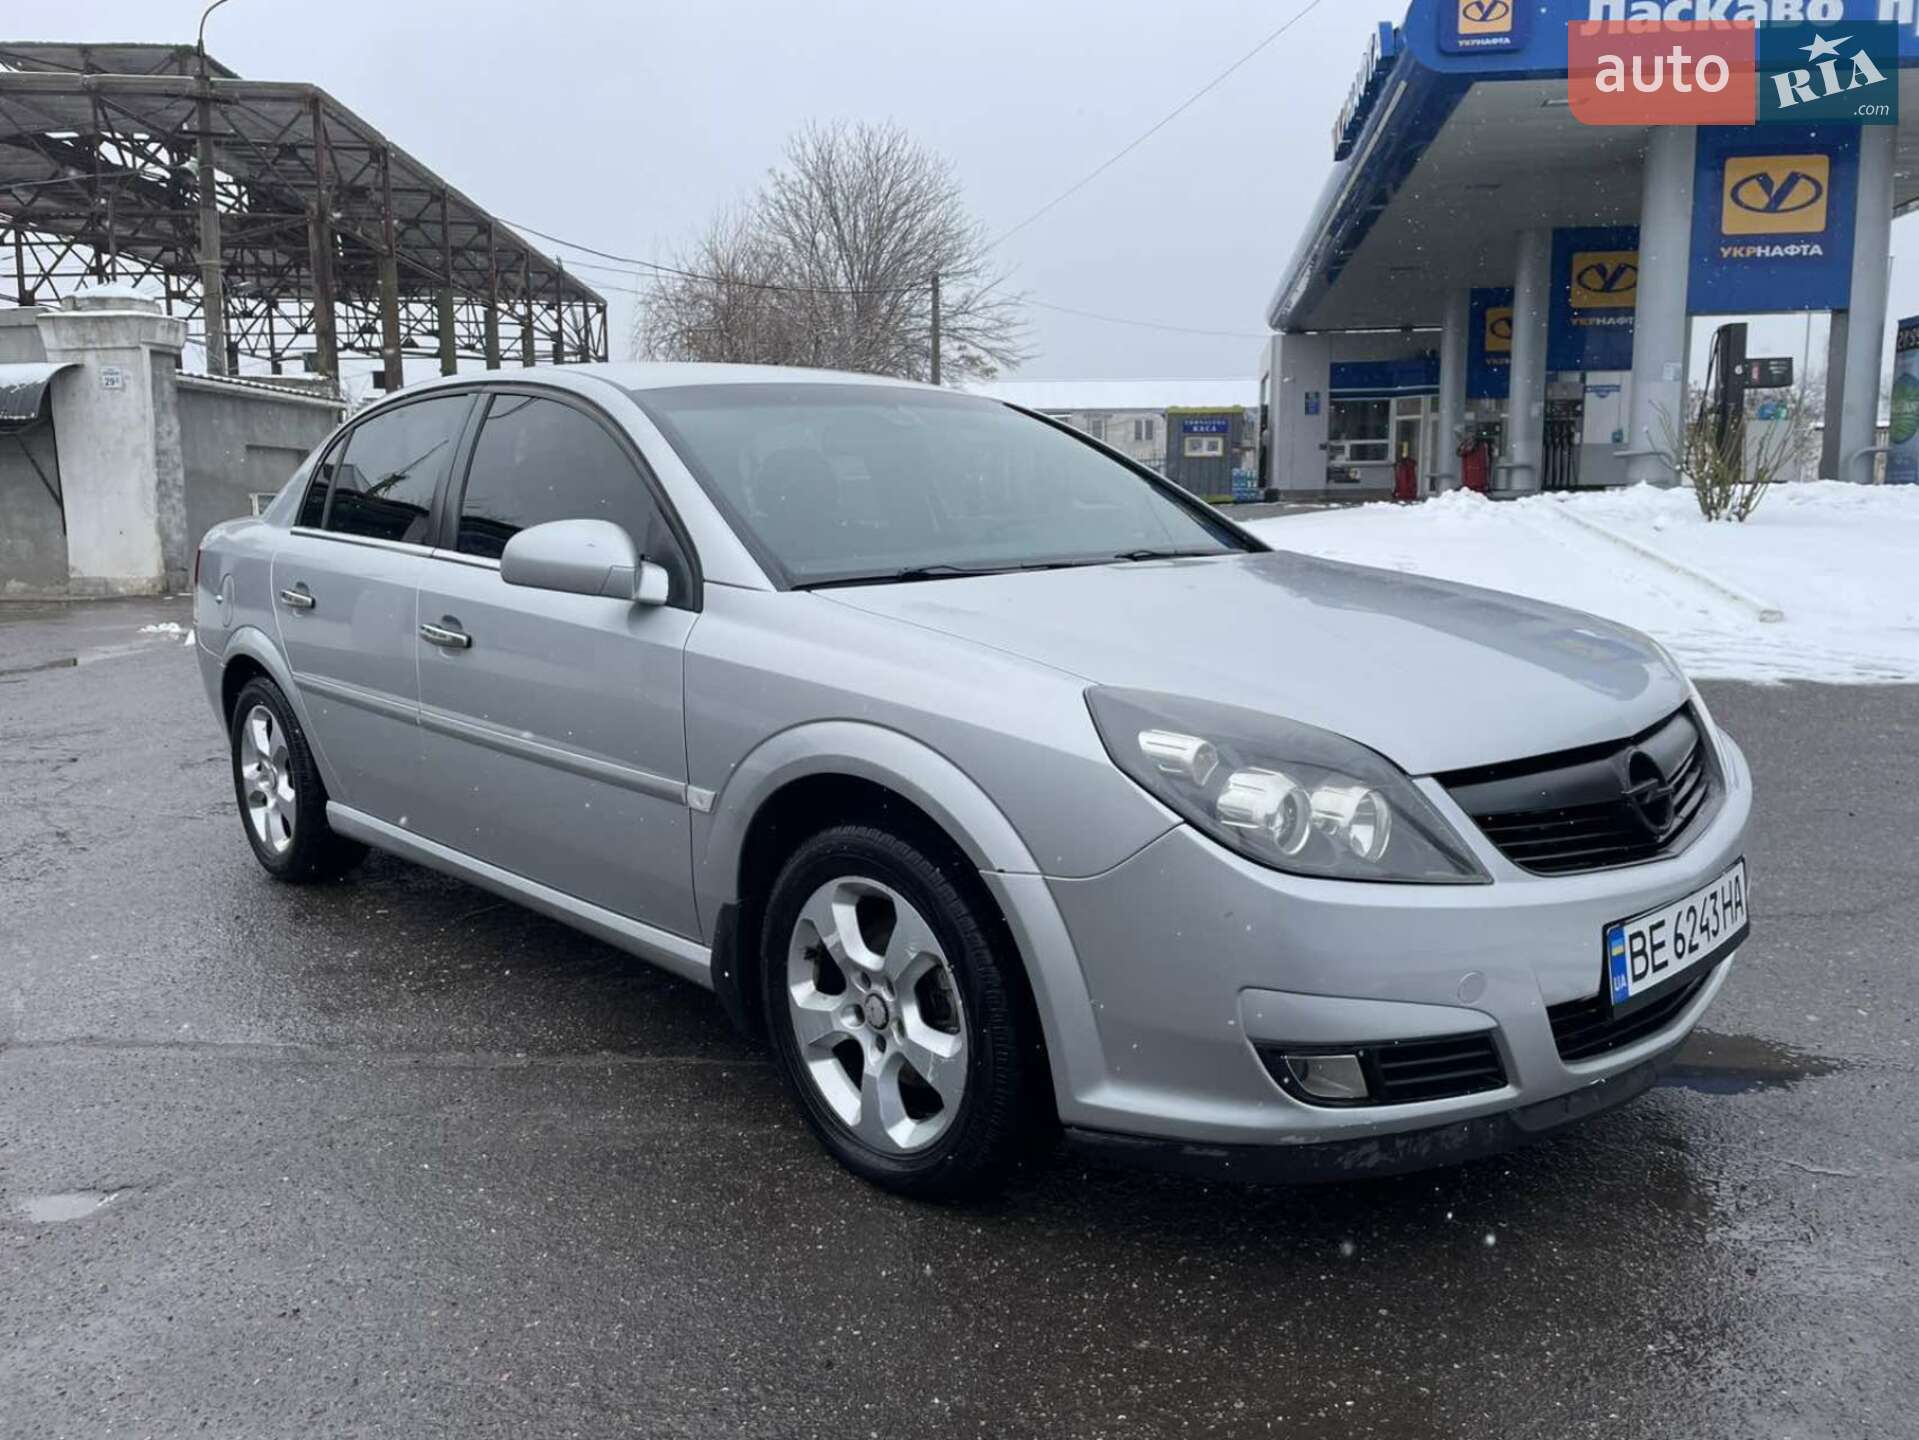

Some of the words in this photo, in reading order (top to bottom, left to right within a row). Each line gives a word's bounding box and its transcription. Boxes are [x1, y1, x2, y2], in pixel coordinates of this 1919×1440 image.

[1720, 244, 1824, 258] УКРНАФТА
[1570, 316, 1634, 326] УКРНАФТ
[1629, 920, 1669, 983] BE
[1673, 891, 1720, 960] 6243
[1721, 875, 1745, 931] HA
[1613, 975, 1627, 991] UA
